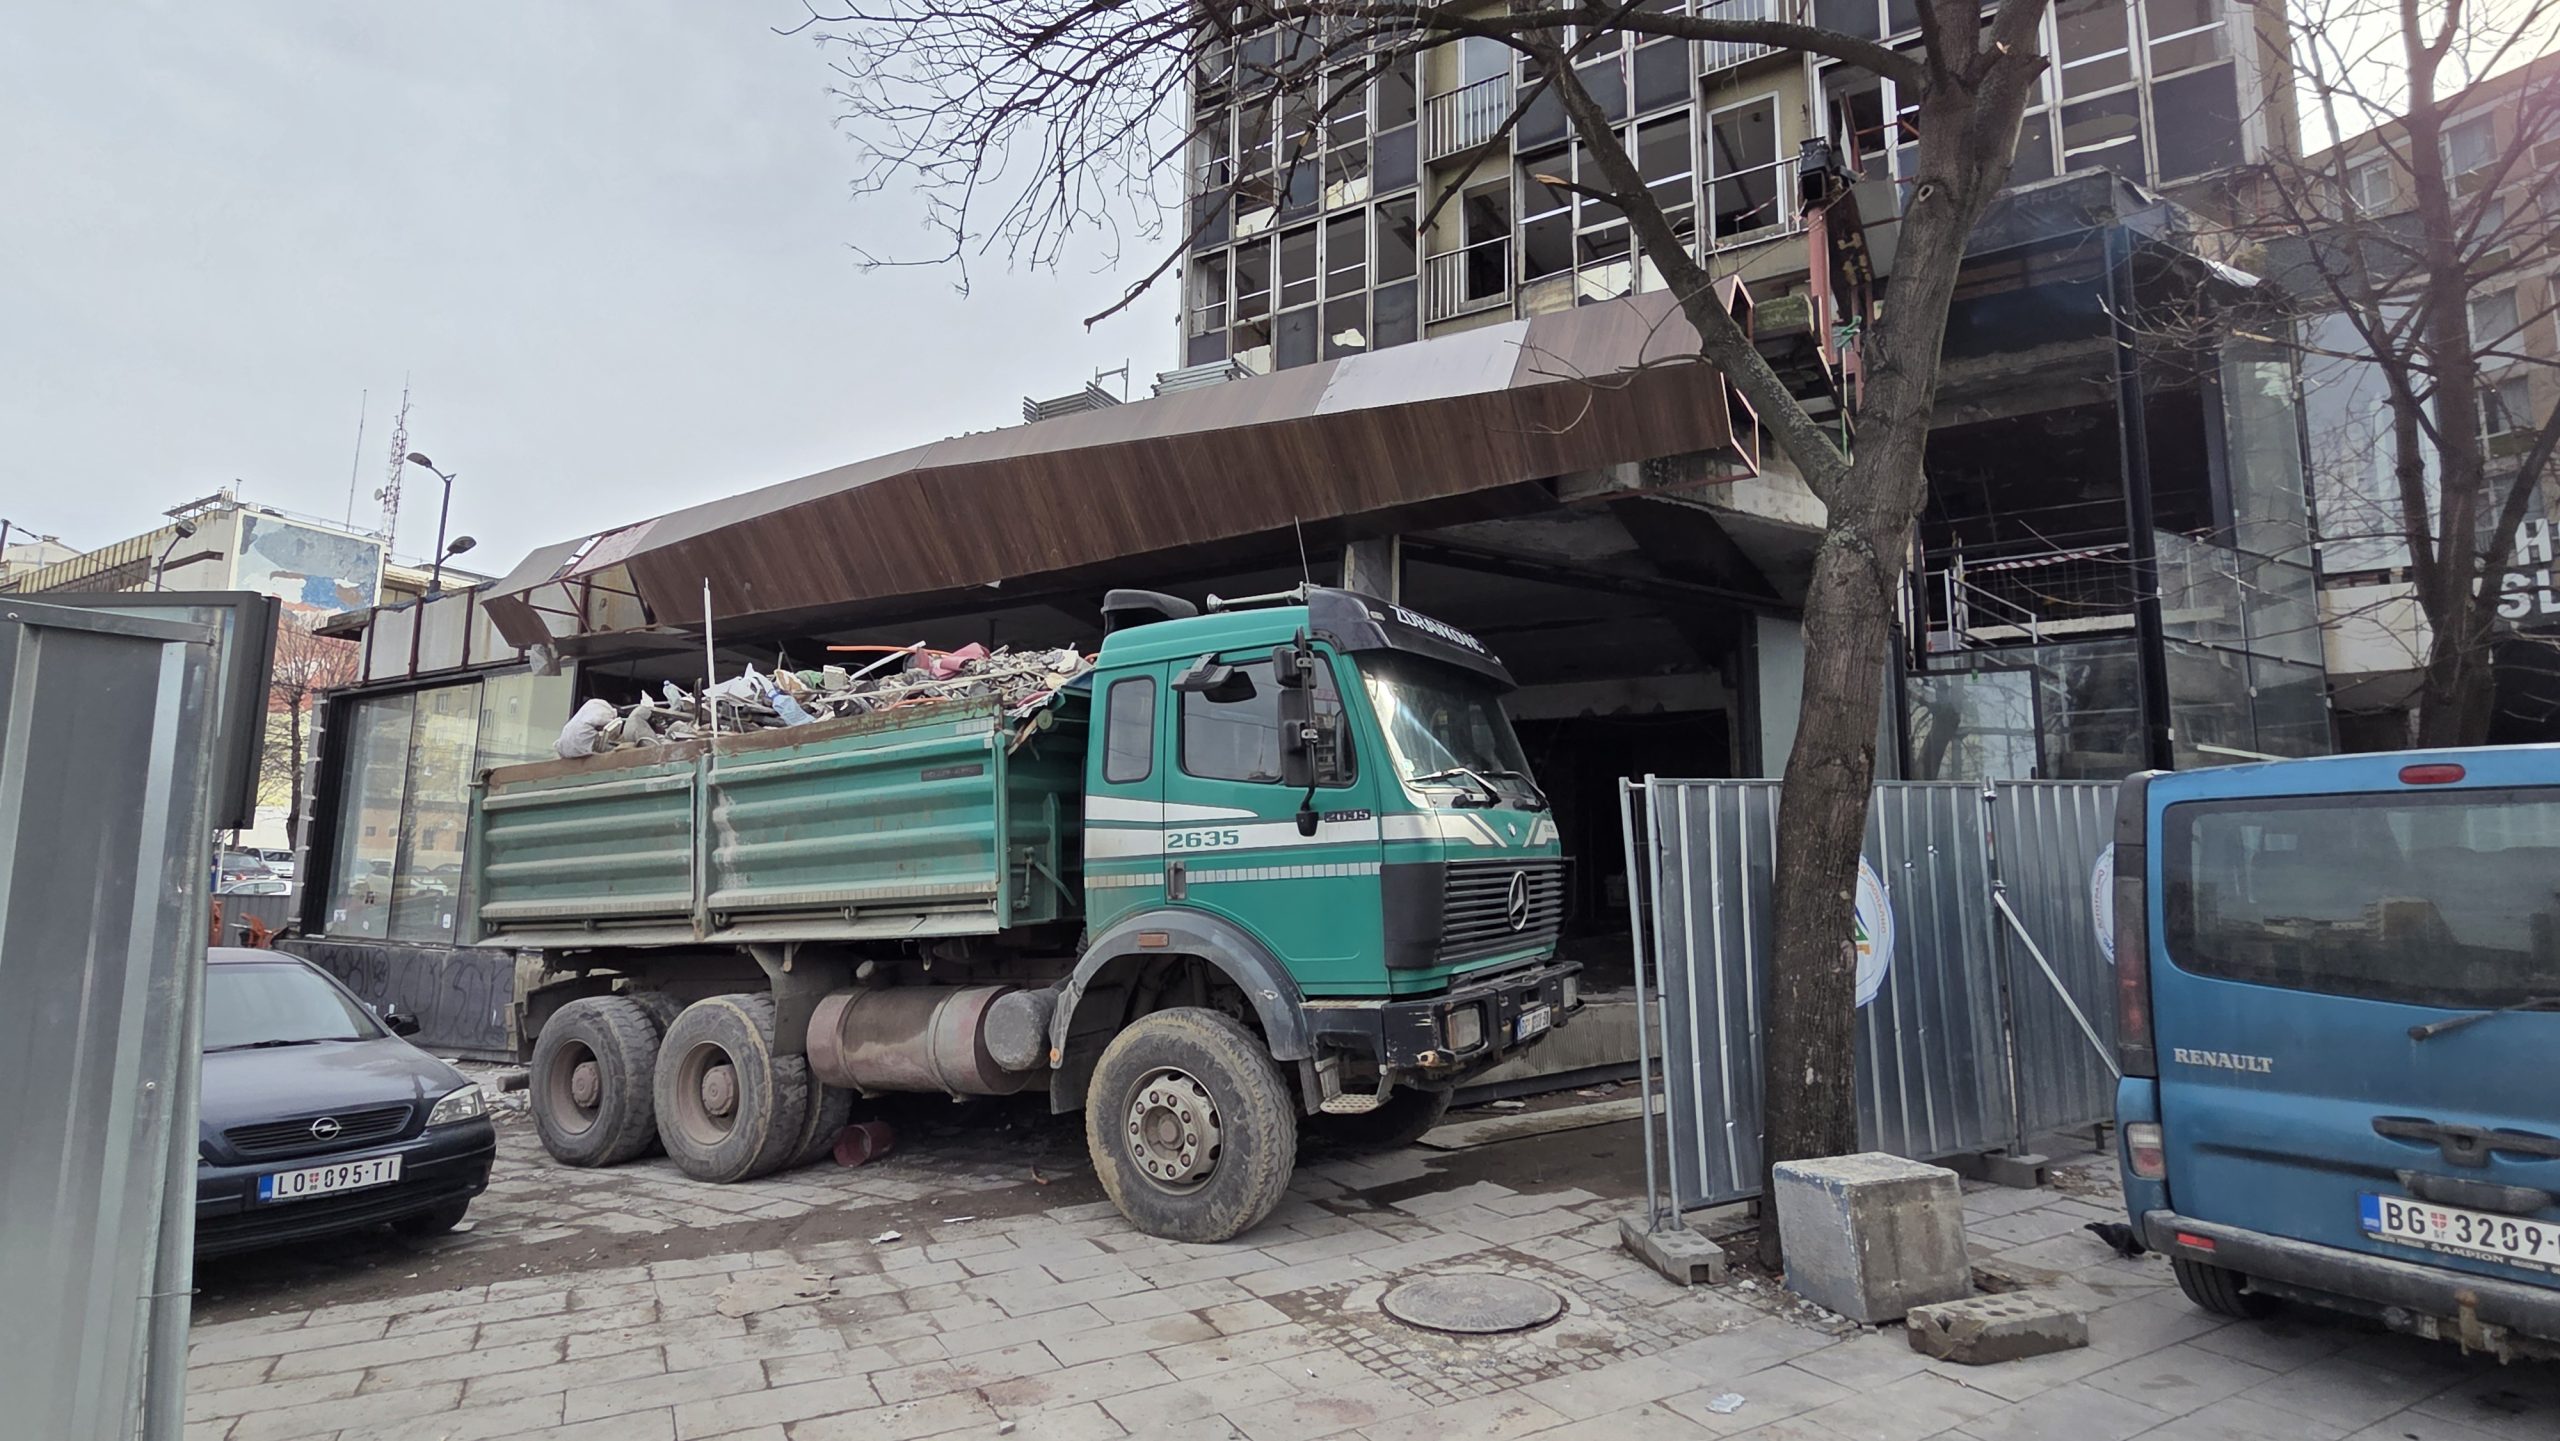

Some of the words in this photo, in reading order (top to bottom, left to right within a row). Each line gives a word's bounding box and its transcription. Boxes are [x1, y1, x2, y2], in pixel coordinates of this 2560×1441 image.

[2515, 518, 2560, 566] H
[1325, 810, 1369, 821] 2635
[1167, 829, 1239, 849] 2635
[2173, 1047, 2273, 1073] RENAULT
[278, 1173, 305, 1195] LO
[2386, 1202, 2426, 1235] BG
[2454, 1214, 2560, 1256] 3209-
